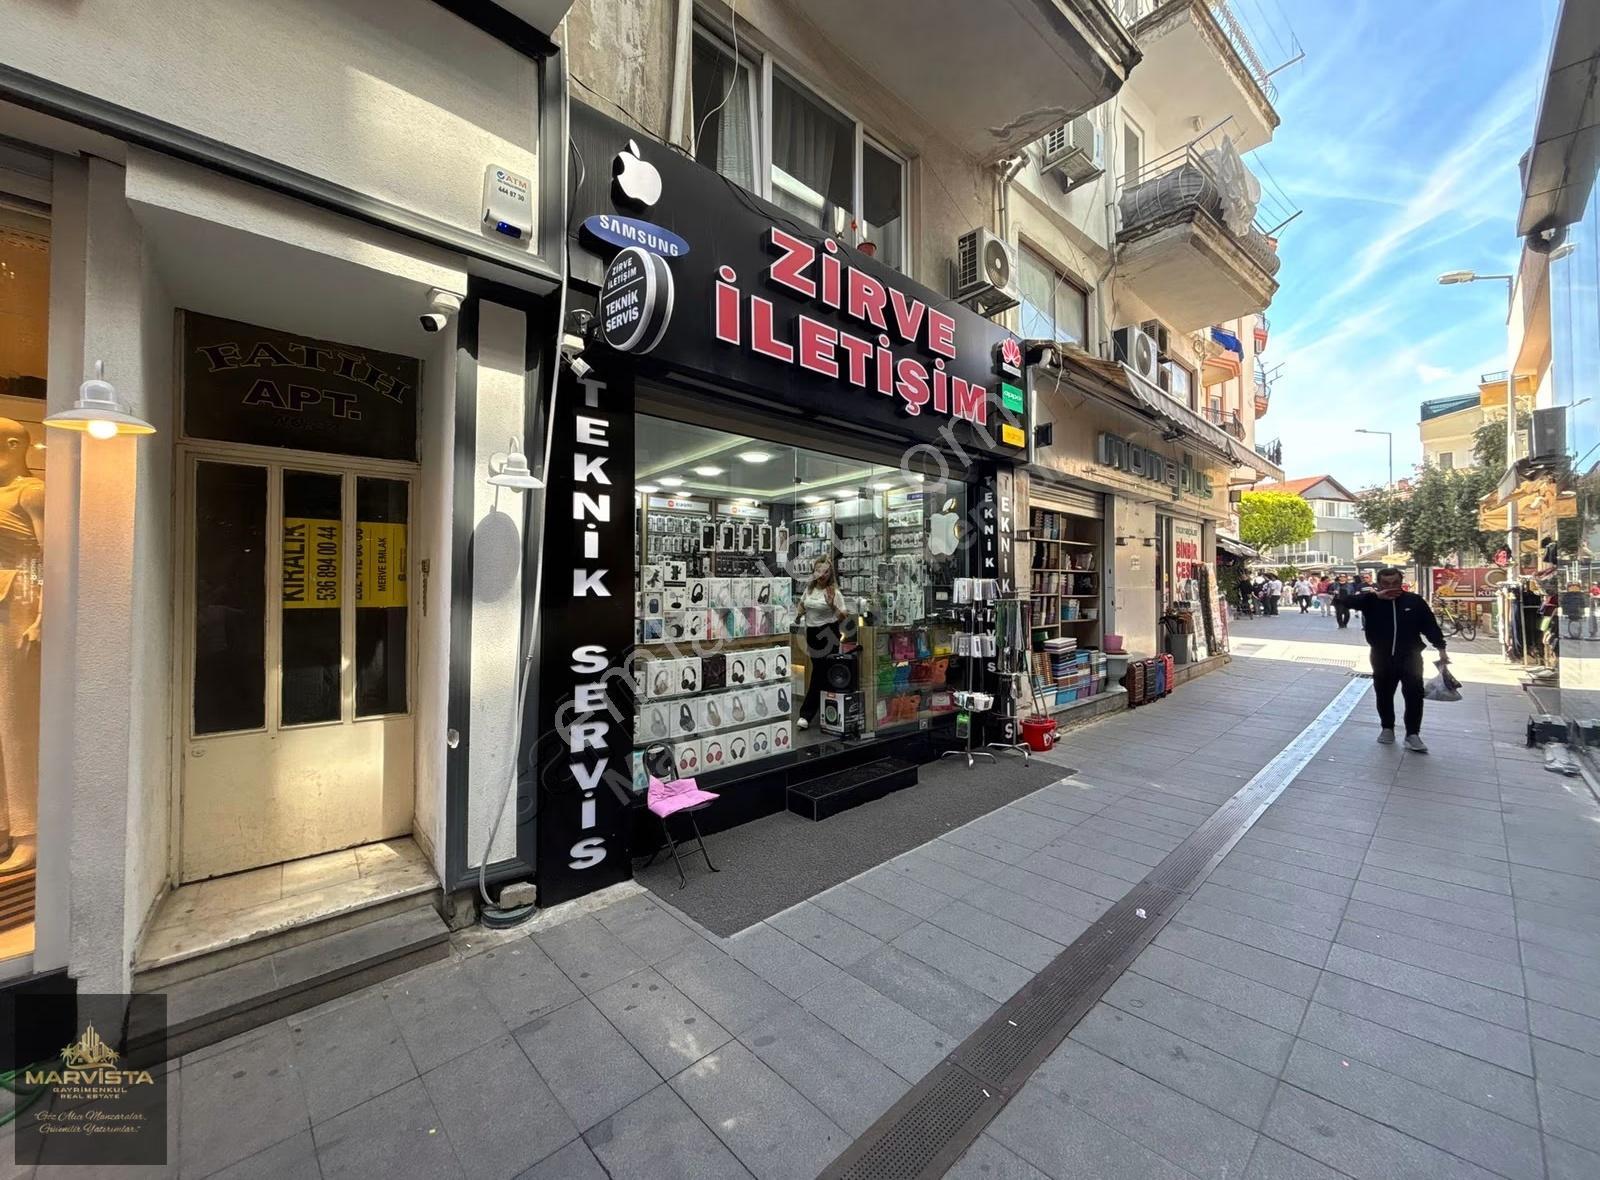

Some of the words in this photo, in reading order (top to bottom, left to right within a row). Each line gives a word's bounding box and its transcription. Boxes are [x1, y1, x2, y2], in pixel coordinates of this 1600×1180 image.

[506, 175, 527, 189] ATM
[599, 214, 679, 257] SAMSUNG
[607, 267, 637, 290] İLETİŞİM
[611, 257, 633, 276] ZİRVE
[606, 289, 639, 317] TEKNİK
[771, 226, 957, 359] ZİRVE
[606, 305, 639, 333] SERVİS
[715, 264, 987, 427] İLETİŞİM
[241, 378, 362, 421] APT.
[572, 376, 612, 598] TEKNİK
[316, 526, 337, 540] 44
[1000, 474, 1012, 593] TEKNİK
[316, 542, 337, 555] 00
[377, 537, 388, 564] EMLAK
[316, 558, 337, 578] 894
[377, 565, 388, 592] MERVE
[316, 581, 337, 601] 536
[568, 644, 610, 870] SERVİS
